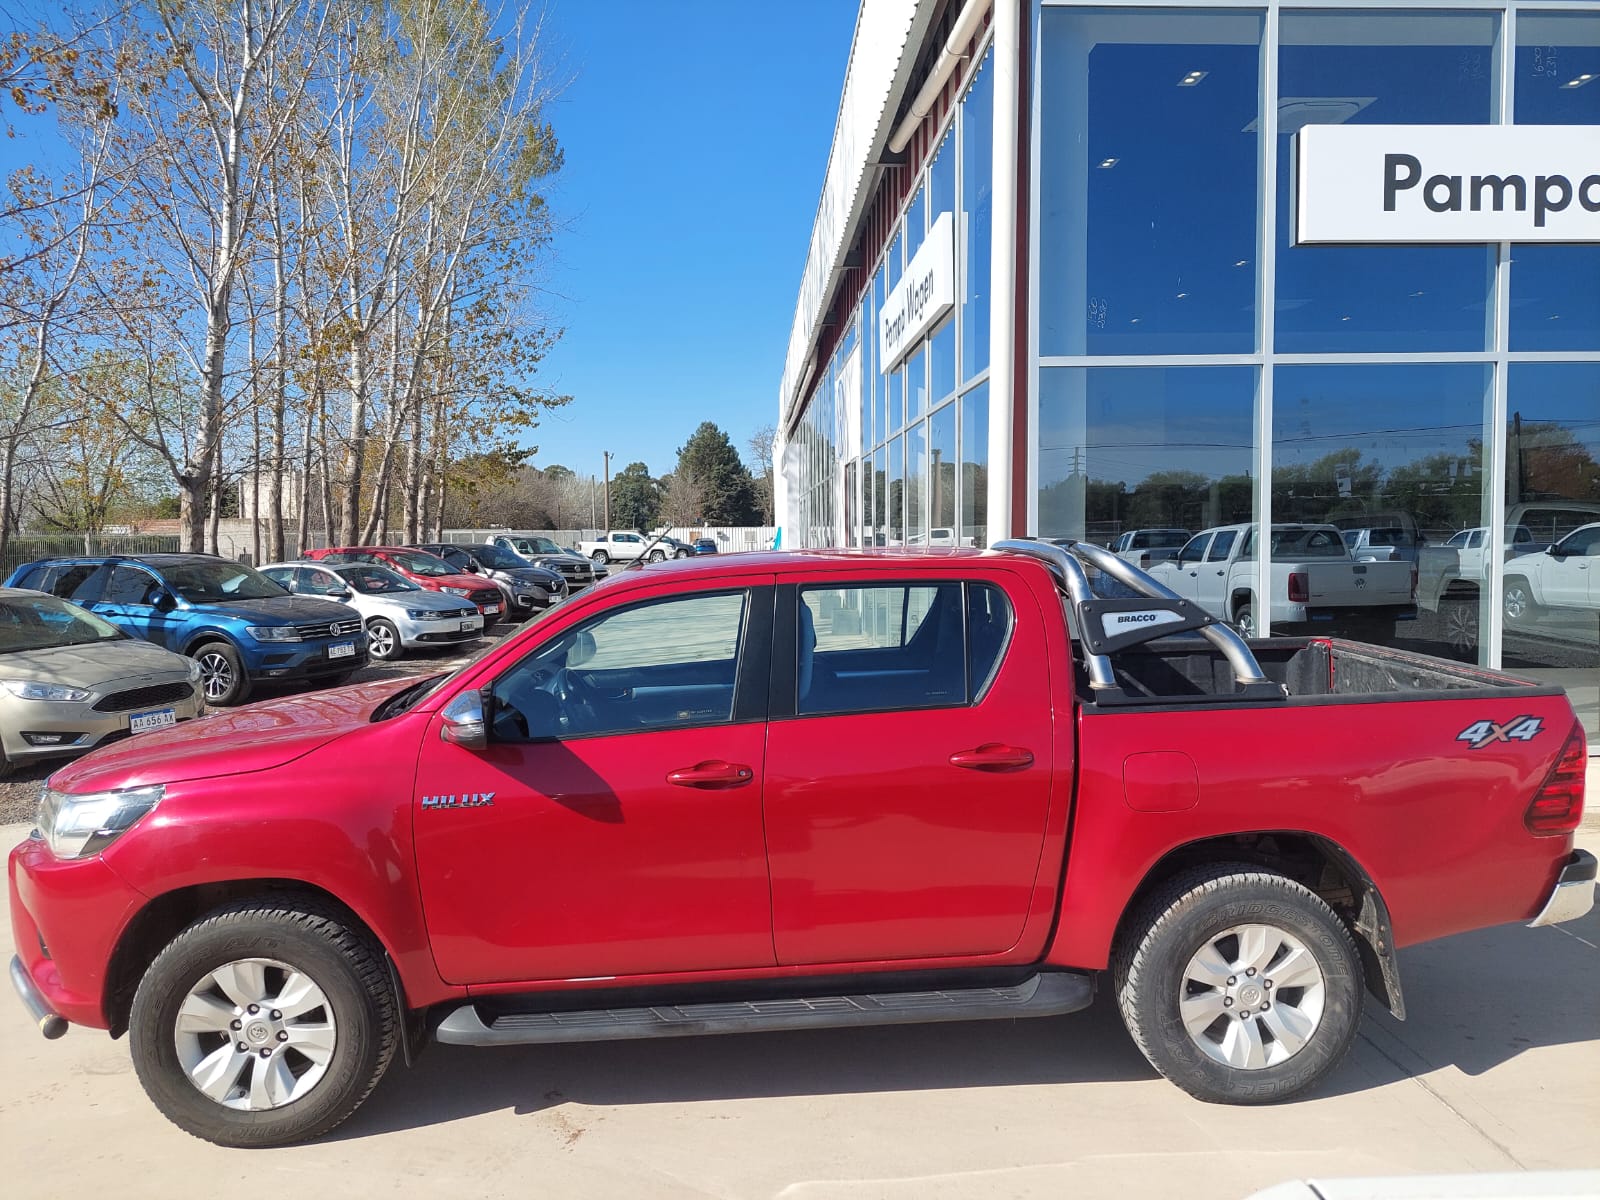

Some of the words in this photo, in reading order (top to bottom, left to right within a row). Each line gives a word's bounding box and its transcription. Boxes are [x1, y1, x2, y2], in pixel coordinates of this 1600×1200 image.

[885, 307, 905, 353] Pampa
[906, 268, 934, 325] Wagen
[1117, 614, 1157, 624] BRACCO
[133, 718, 144, 729] AA
[146, 715, 162, 726] 656
[422, 791, 496, 811] HILUX
